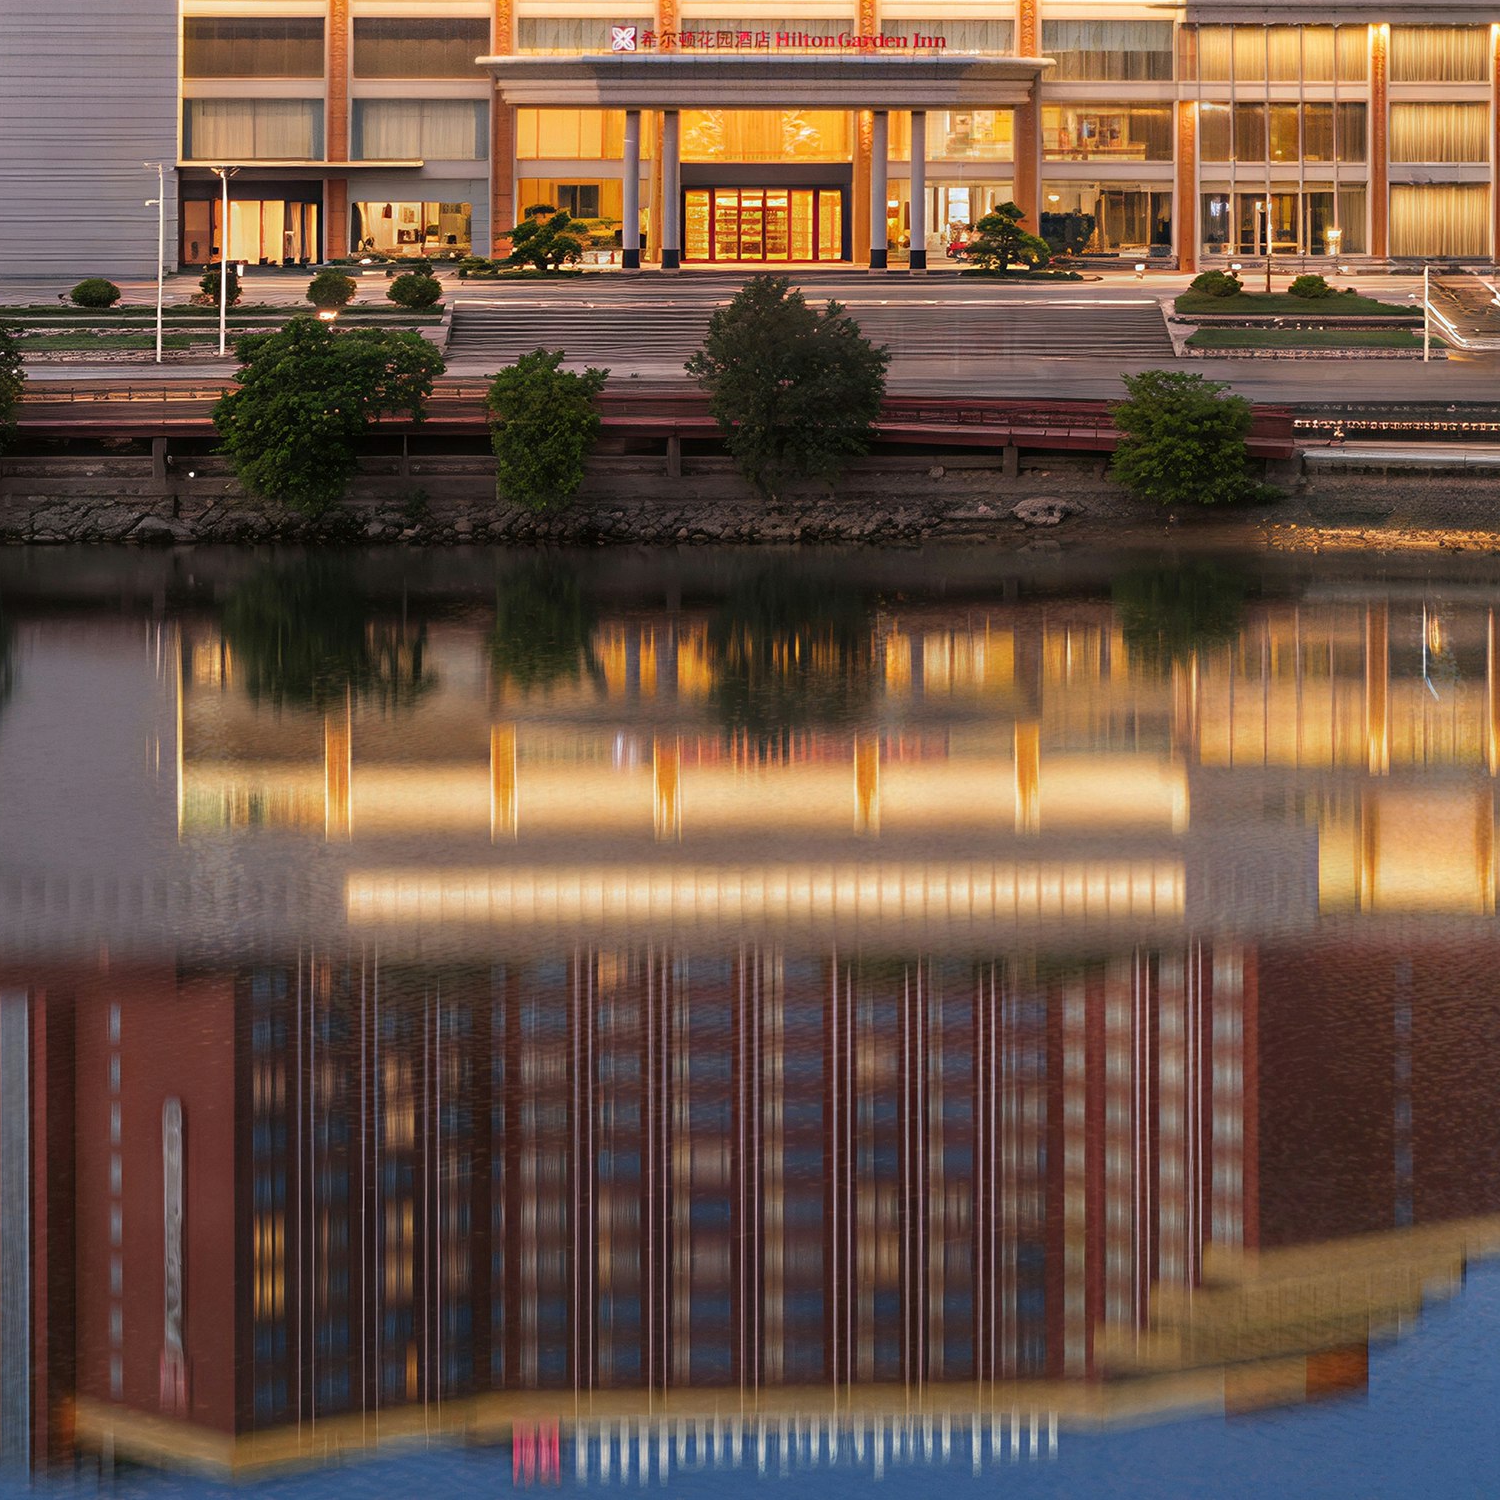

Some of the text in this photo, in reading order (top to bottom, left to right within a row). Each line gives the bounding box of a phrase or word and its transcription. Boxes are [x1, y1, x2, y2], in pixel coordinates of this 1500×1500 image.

[640, 29, 947, 49] 希尔顿花园酒店 Hilton Garden Inn
